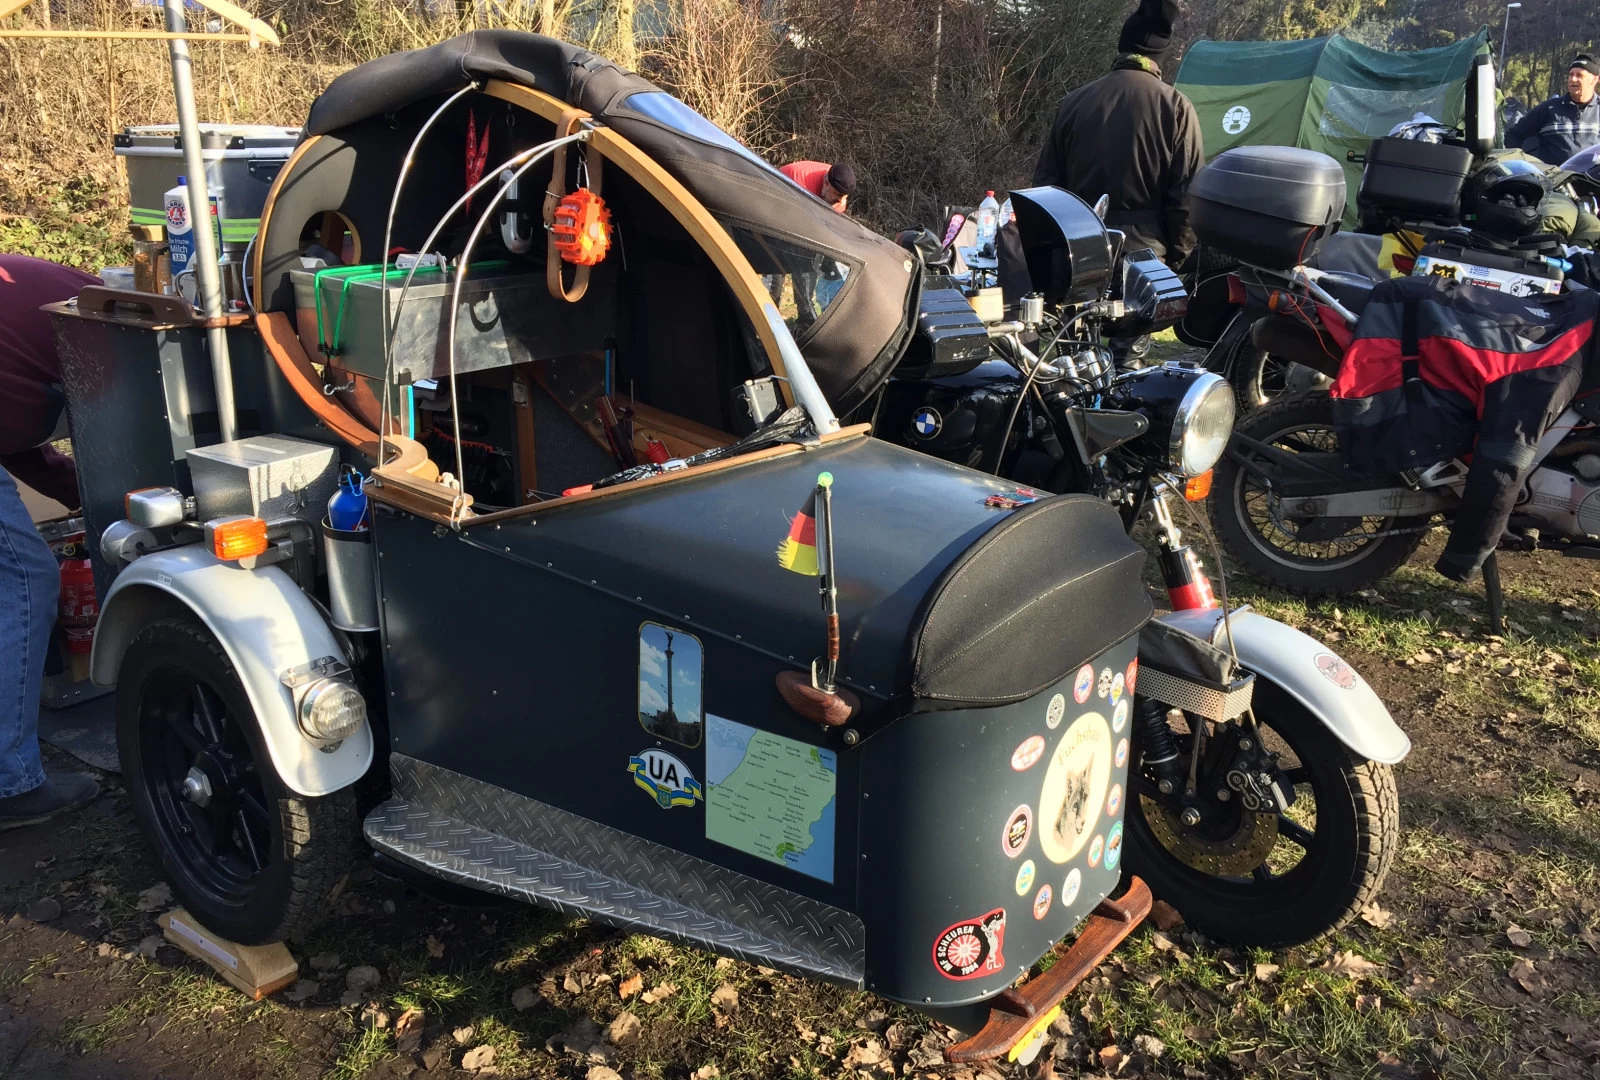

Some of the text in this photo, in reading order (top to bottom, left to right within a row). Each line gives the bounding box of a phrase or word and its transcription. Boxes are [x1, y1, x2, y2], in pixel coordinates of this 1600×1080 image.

[170, 244, 188, 254] Milch
[649, 754, 680, 788] UA
[937, 925, 975, 957] SCHEUREN
[961, 962, 979, 975] 1984
